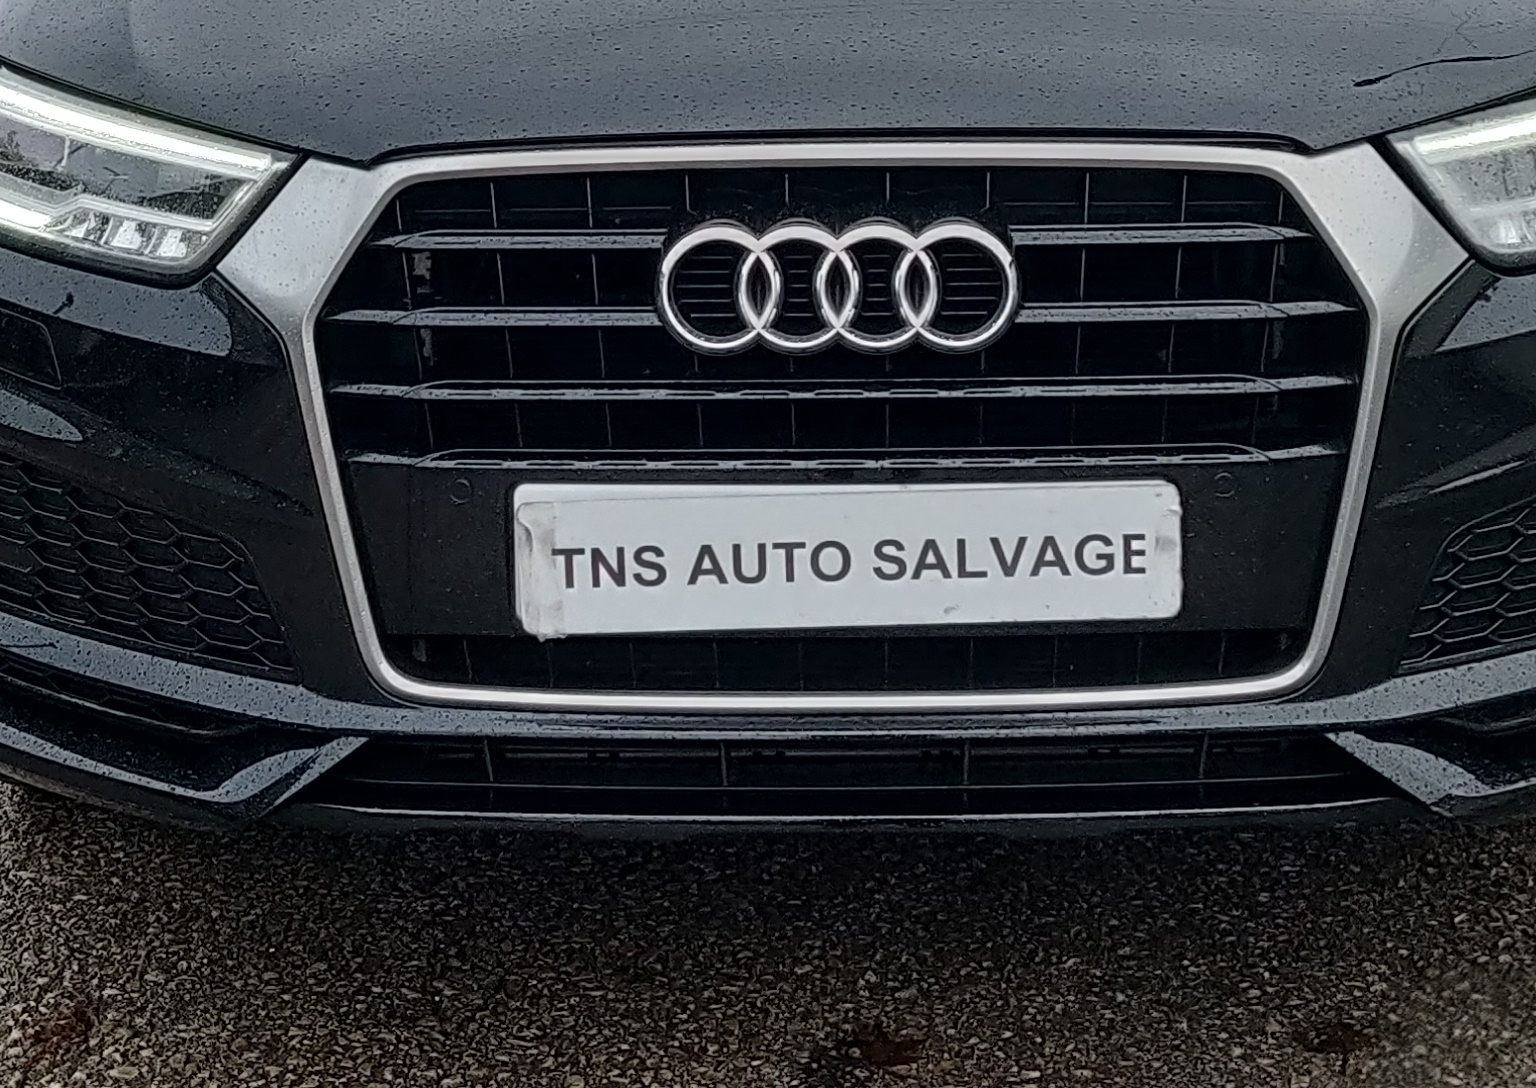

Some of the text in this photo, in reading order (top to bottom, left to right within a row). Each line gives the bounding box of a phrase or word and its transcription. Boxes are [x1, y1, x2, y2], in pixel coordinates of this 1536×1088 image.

[551, 533, 1147, 589] TNS AUTO SALVAGE
